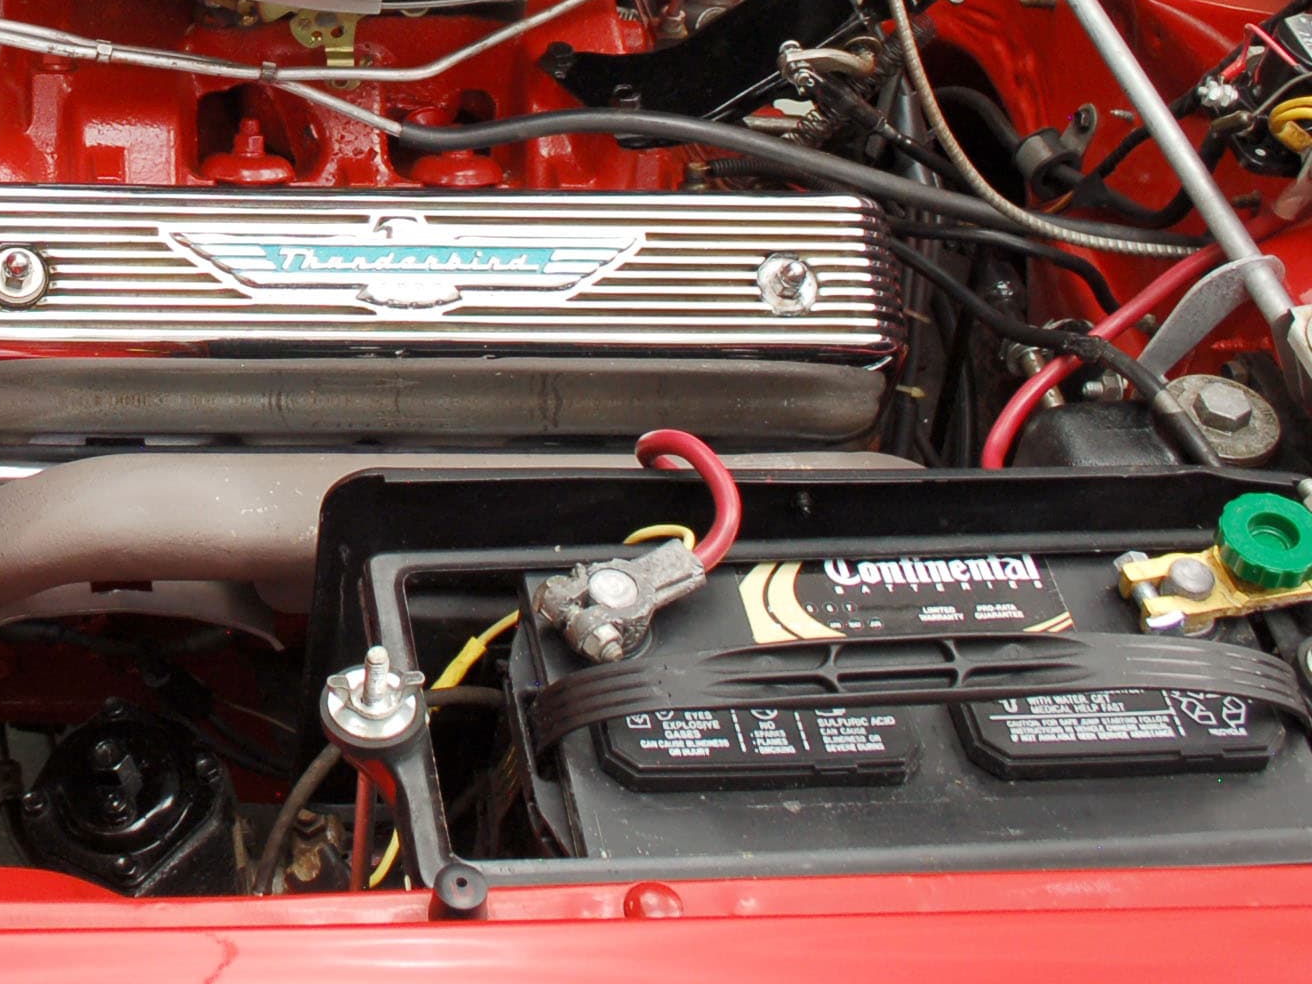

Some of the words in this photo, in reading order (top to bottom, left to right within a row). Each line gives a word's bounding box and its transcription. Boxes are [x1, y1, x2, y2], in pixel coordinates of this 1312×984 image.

[279, 247, 540, 272] Thunderbird
[824, 553, 1041, 585] Continental
[1026, 696, 1053, 705] WITH
[1090, 694, 1110, 704] GET
[1030, 704, 1075, 714] MEDICAL
[1073, 703, 1099, 713] HELP
[1100, 702, 1125, 712] FAST
[684, 711, 713, 720] EYES
[662, 720, 720, 730] EXPLOSIVE
[759, 720, 775, 730] NO
[817, 717, 869, 727] SULFURIC
[870, 716, 896, 727] ACID
[664, 729, 702, 739] GASES
[819, 728, 838, 736] CAN
[839, 727, 867, 735] CAUSE
[640, 739, 658, 749] CAN
[658, 739, 685, 748] CAUSE
[685, 738, 730, 748] BLINDNESS
[822, 735, 867, 744] BLINDNESS
[868, 734, 882, 742] OR
[681, 747, 710, 756] INJURY
[825, 743, 858, 752] SEVERE
[857, 742, 885, 751] BURNS
